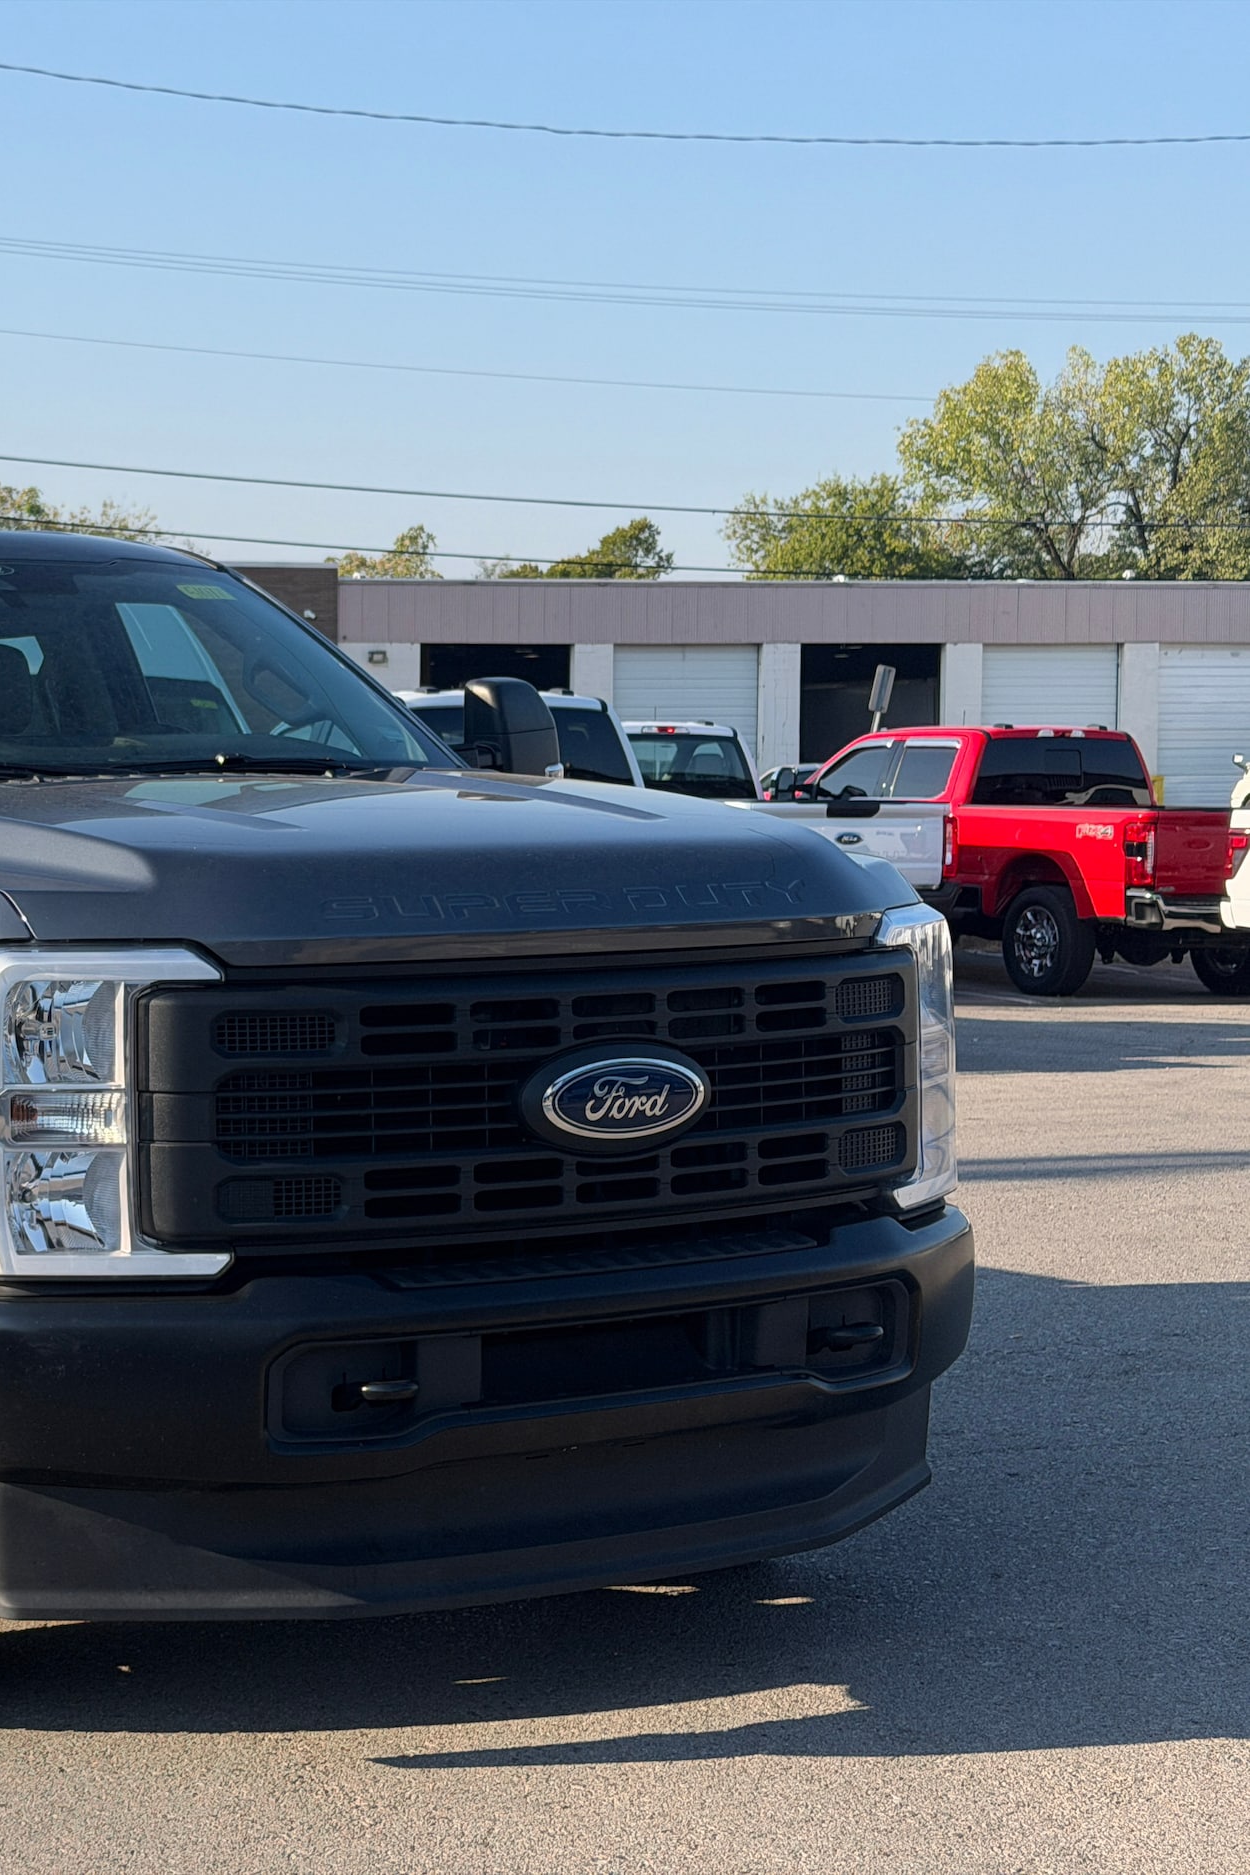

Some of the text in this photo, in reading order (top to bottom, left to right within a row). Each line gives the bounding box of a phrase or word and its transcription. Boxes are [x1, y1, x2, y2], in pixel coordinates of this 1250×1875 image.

[322, 878, 805, 922] SUPER DUTY
[585, 1075, 671, 1122] Ford
